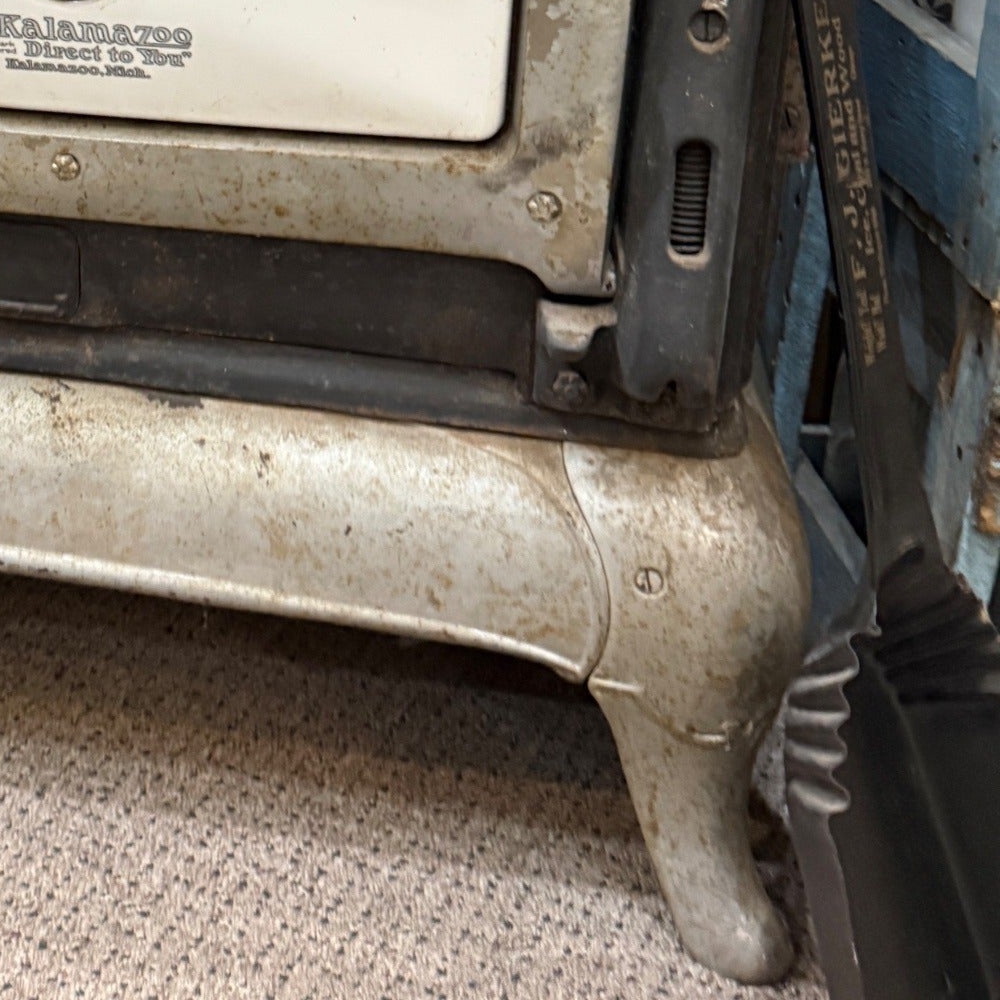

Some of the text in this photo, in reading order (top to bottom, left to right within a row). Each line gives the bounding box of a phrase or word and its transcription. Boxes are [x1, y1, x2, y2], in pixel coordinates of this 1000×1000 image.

[24, 40, 102, 62] Direct
[107, 47, 134, 64] to
[813, 0, 850, 183] GIERKE
[831, 16, 851, 95] Wood
